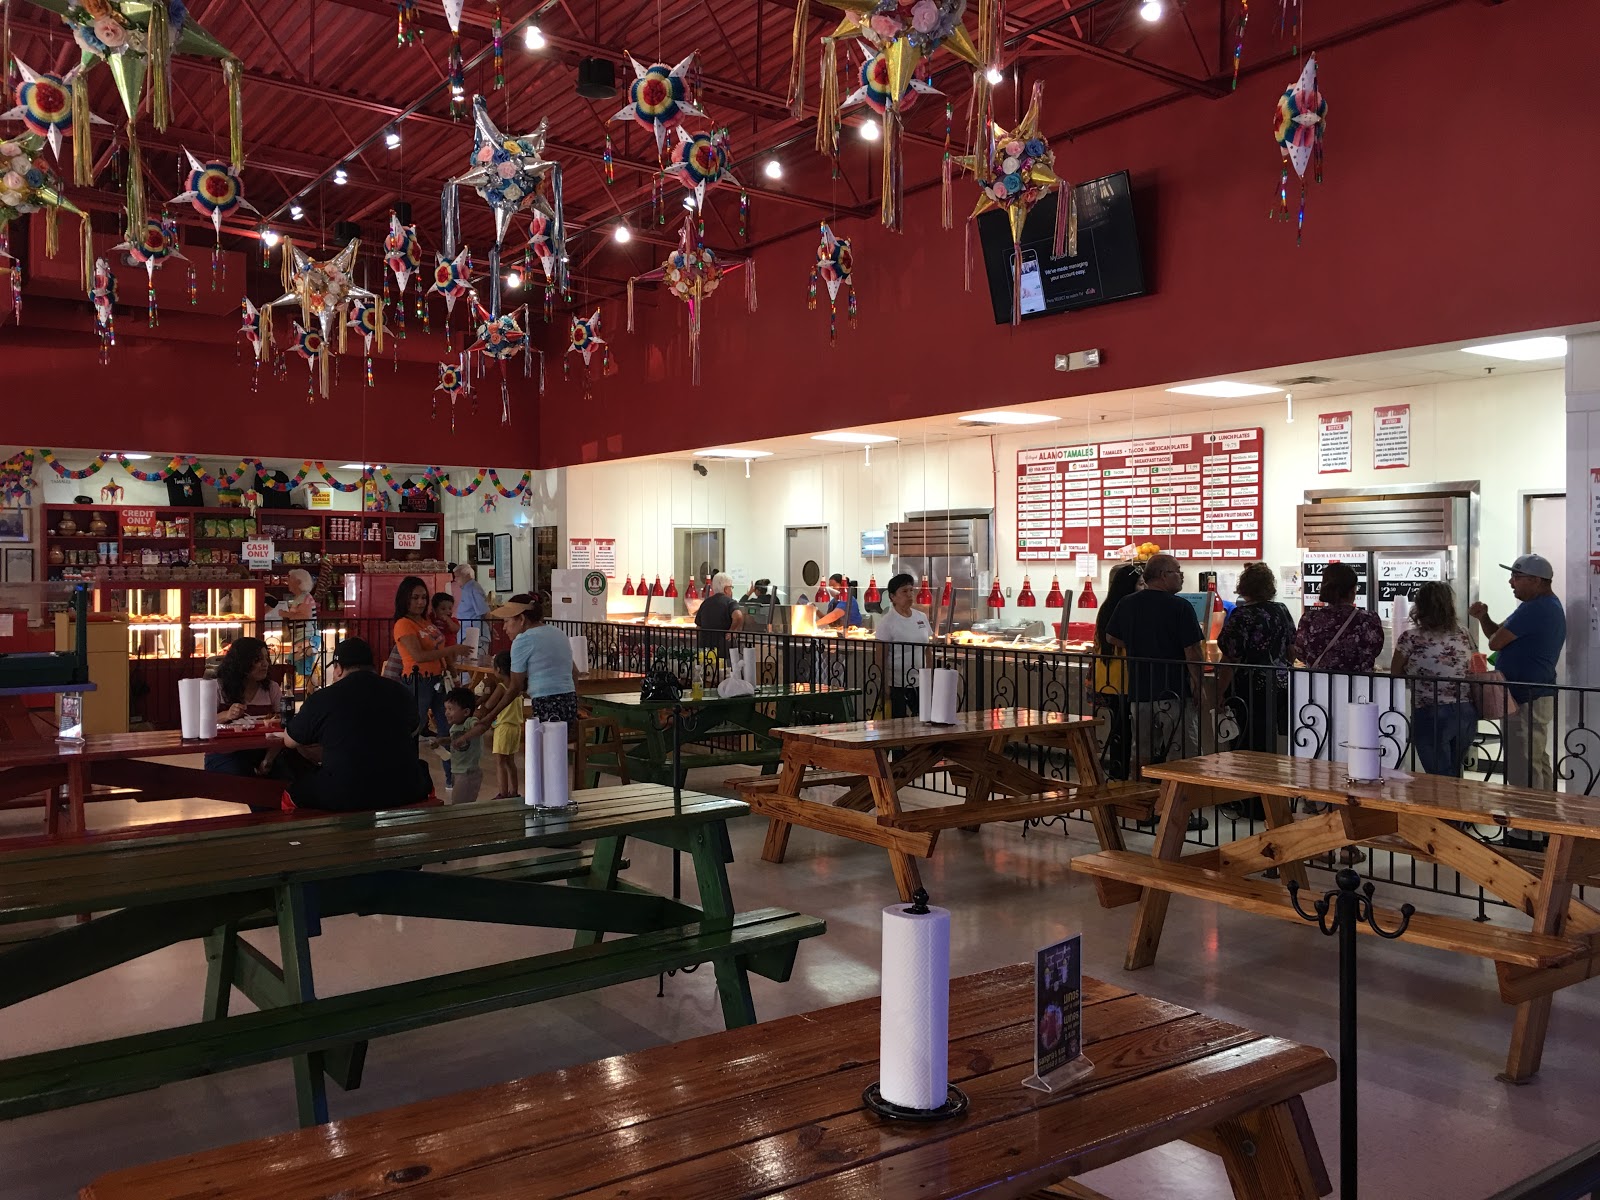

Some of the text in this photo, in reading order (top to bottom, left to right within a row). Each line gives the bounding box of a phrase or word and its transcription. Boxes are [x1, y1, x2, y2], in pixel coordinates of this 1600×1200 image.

[1069, 261, 1088, 270] managing
[1060, 271, 1076, 279] account
[1039, 450, 1063, 461] ALAMO
[1063, 448, 1094, 459] TAMALES
[122, 509, 154, 518] CREDIT
